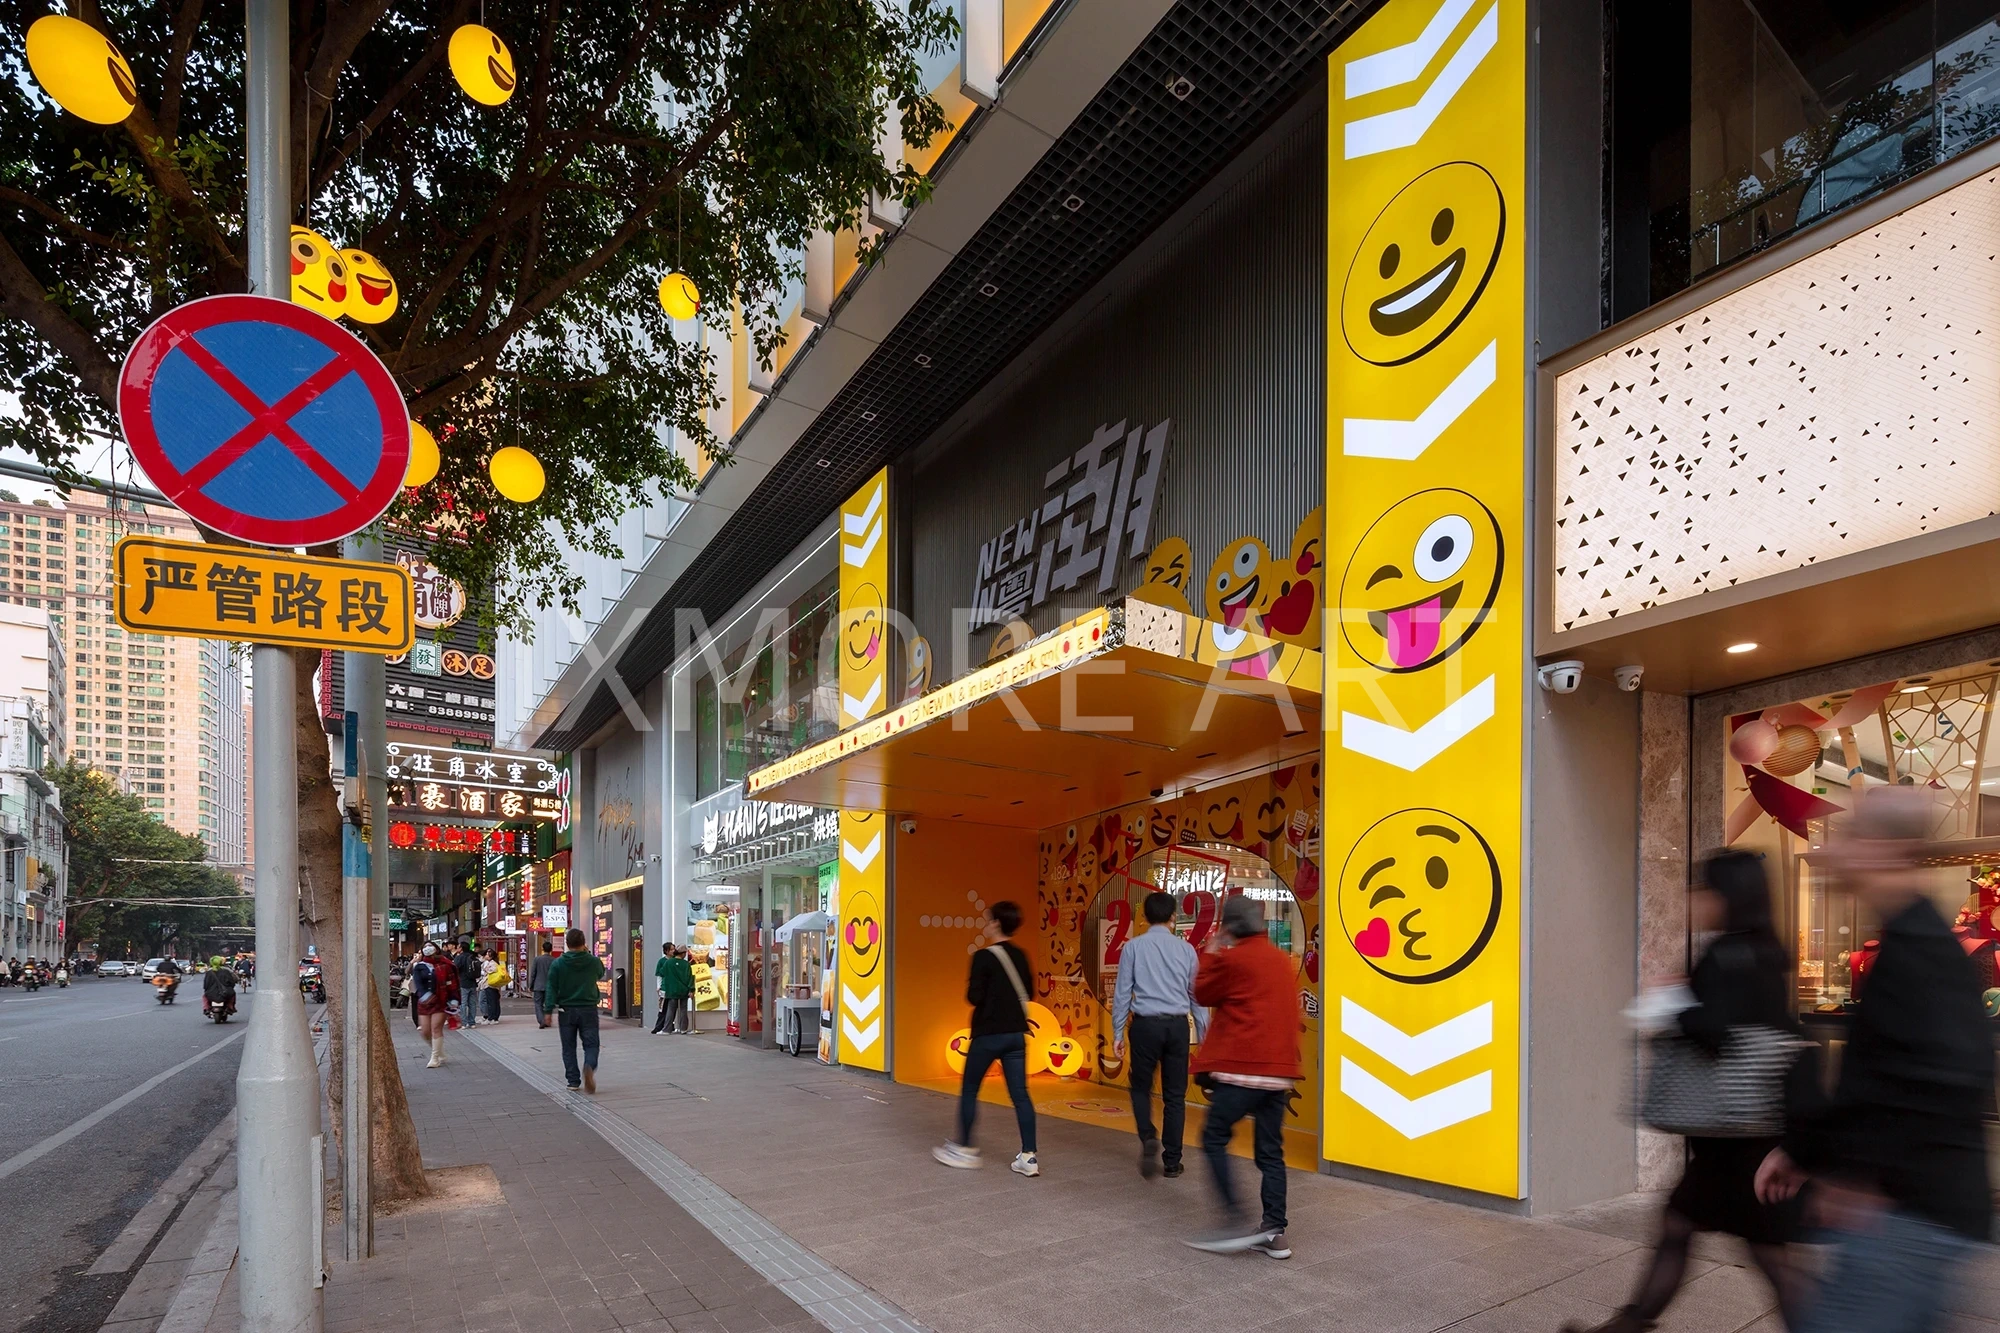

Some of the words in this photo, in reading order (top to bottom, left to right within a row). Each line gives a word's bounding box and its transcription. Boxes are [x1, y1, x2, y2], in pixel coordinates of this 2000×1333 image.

[979, 508, 1040, 581] NEW
[139, 557, 392, 635] 严管路段
[968, 562, 999, 635] IN
[922, 695, 945, 716] NEW
[944, 690, 957, 706] IN
[979, 671, 1009, 693] laugh
[1012, 653, 1037, 683] park
[429, 706, 495, 722] 83889963
[413, 753, 527, 783] 旺角冰室
[767, 769, 780, 782] NEW
[799, 756, 814, 770] laugh
[814, 750, 827, 764] park
[813, 810, 840, 842] 烘焙
[529, 919, 542, 929] 凉
